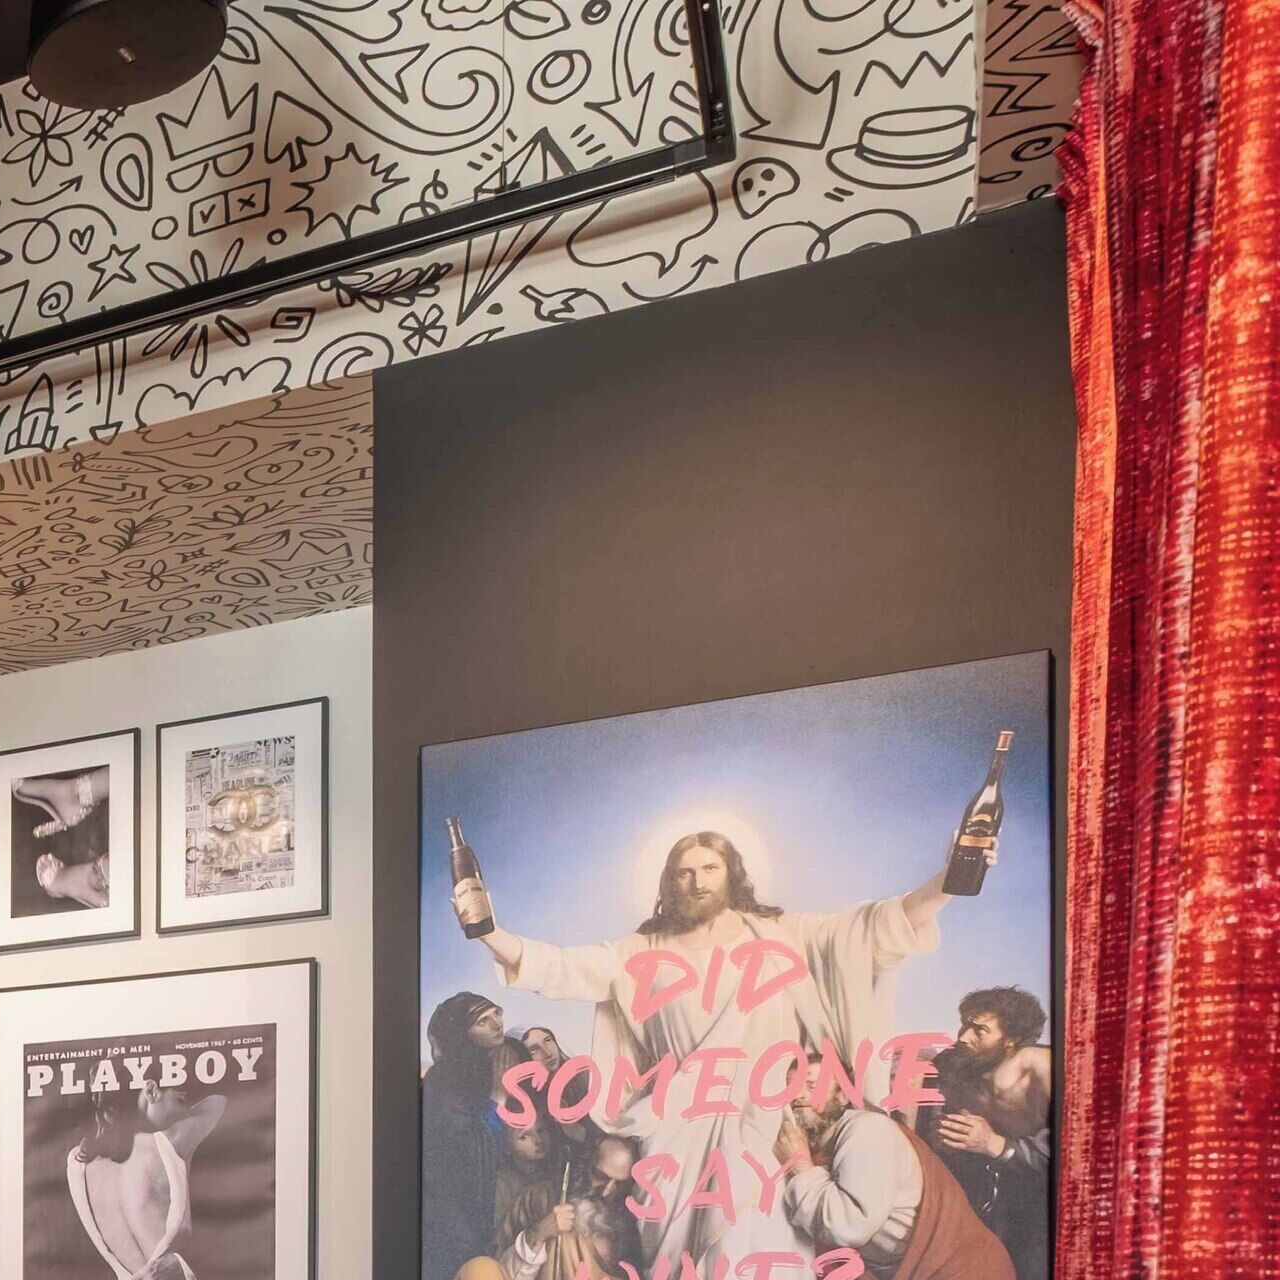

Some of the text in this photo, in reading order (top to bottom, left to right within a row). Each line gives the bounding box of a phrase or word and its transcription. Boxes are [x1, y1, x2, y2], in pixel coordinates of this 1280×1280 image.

[624, 938, 809, 1024] DID
[26, 1044, 151, 1062] ENTERTAINMENT FOR MEN
[26, 1047, 264, 1098] PLAYBOY
[175, 1041, 209, 1050] NOVEMBER
[242, 1036, 263, 1044] CENTS
[496, 1032, 957, 1129] SOMEONE
[624, 1147, 808, 1226] SAY
